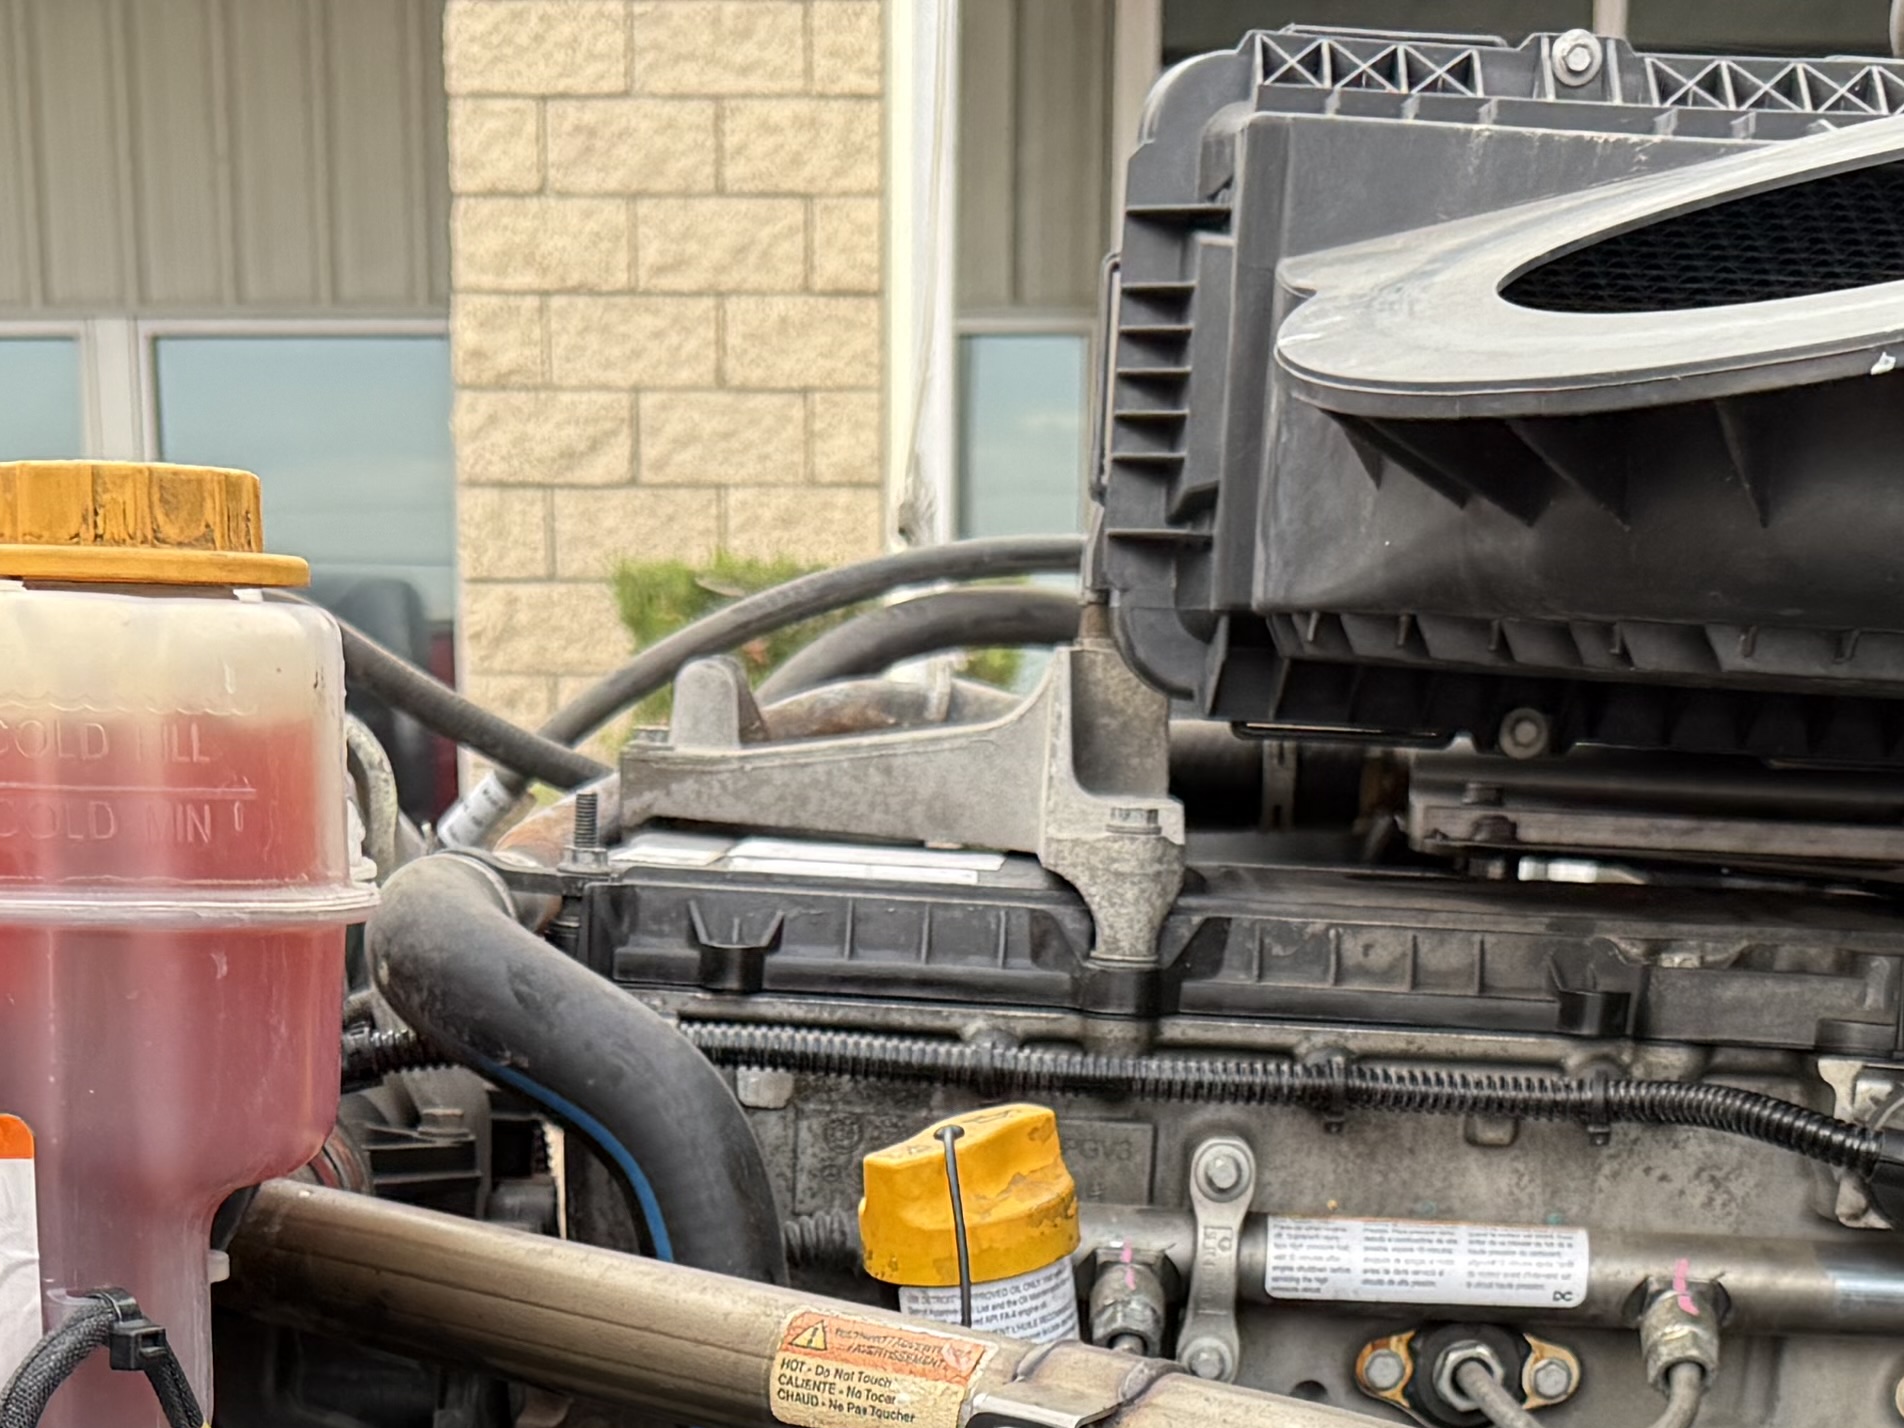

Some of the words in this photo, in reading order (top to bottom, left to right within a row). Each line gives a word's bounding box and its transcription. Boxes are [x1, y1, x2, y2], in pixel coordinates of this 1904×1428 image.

[1553, 1291, 1573, 1302] DC
[780, 1358, 805, 1374] HOT
[815, 1365, 830, 1378] Do
[834, 1369, 854, 1381] Not
[857, 1371, 892, 1388] Touch
[778, 1374, 835, 1395] CALIENTE
[865, 1389, 896, 1404] Tocar
[777, 1388, 819, 1408] CHAUD
[847, 1402, 867, 1416] Pas
[869, 1405, 915, 1424] Toucher
